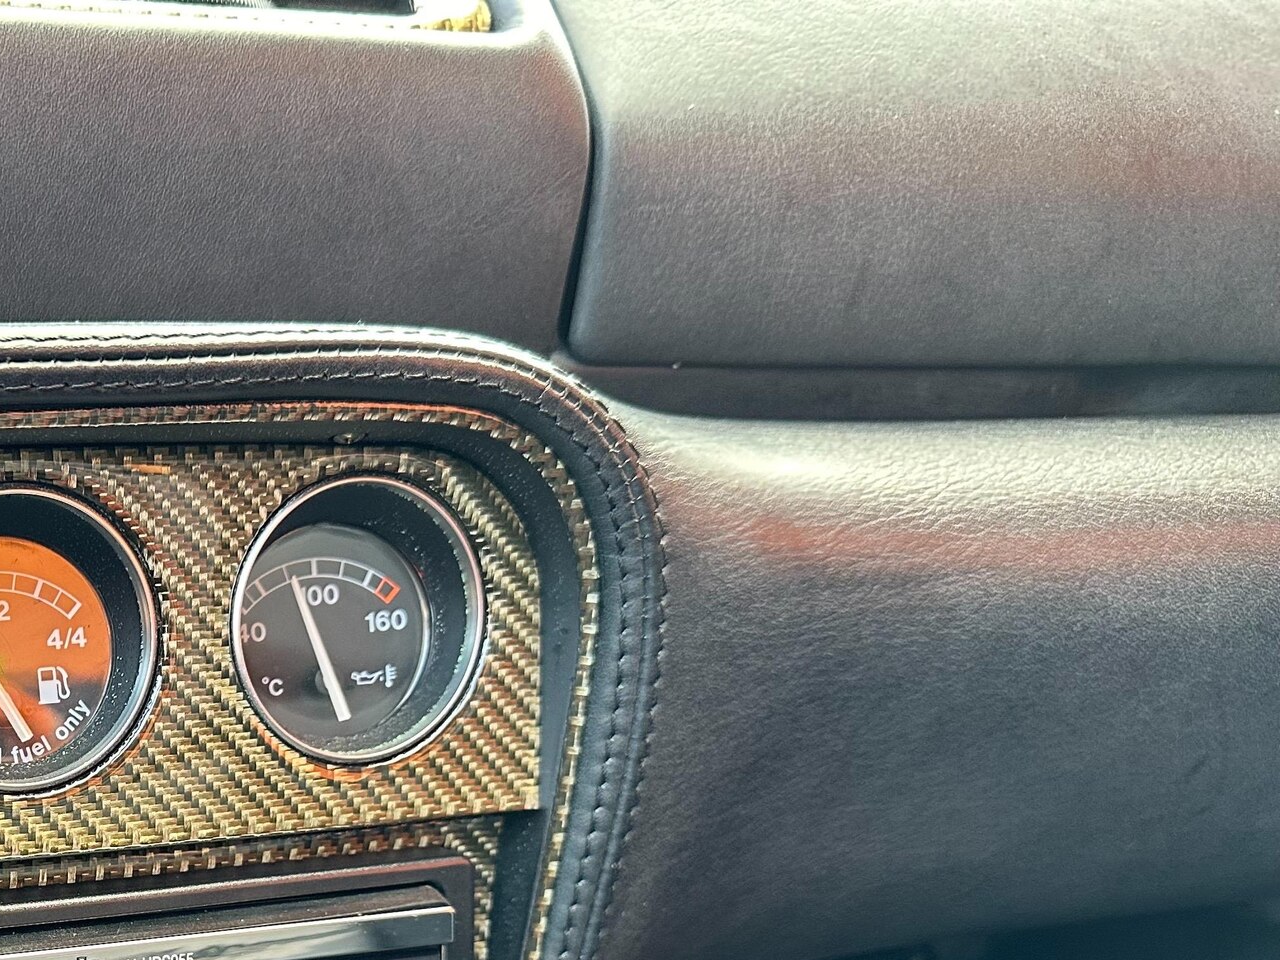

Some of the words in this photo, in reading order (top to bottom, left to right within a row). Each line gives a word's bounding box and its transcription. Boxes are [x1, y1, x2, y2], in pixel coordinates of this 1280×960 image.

[302, 583, 340, 606] 00
[365, 609, 408, 633] 160
[46, 626, 87, 650] 4/4
[10, 735, 52, 766] fuel
[55, 699, 92, 741] only
